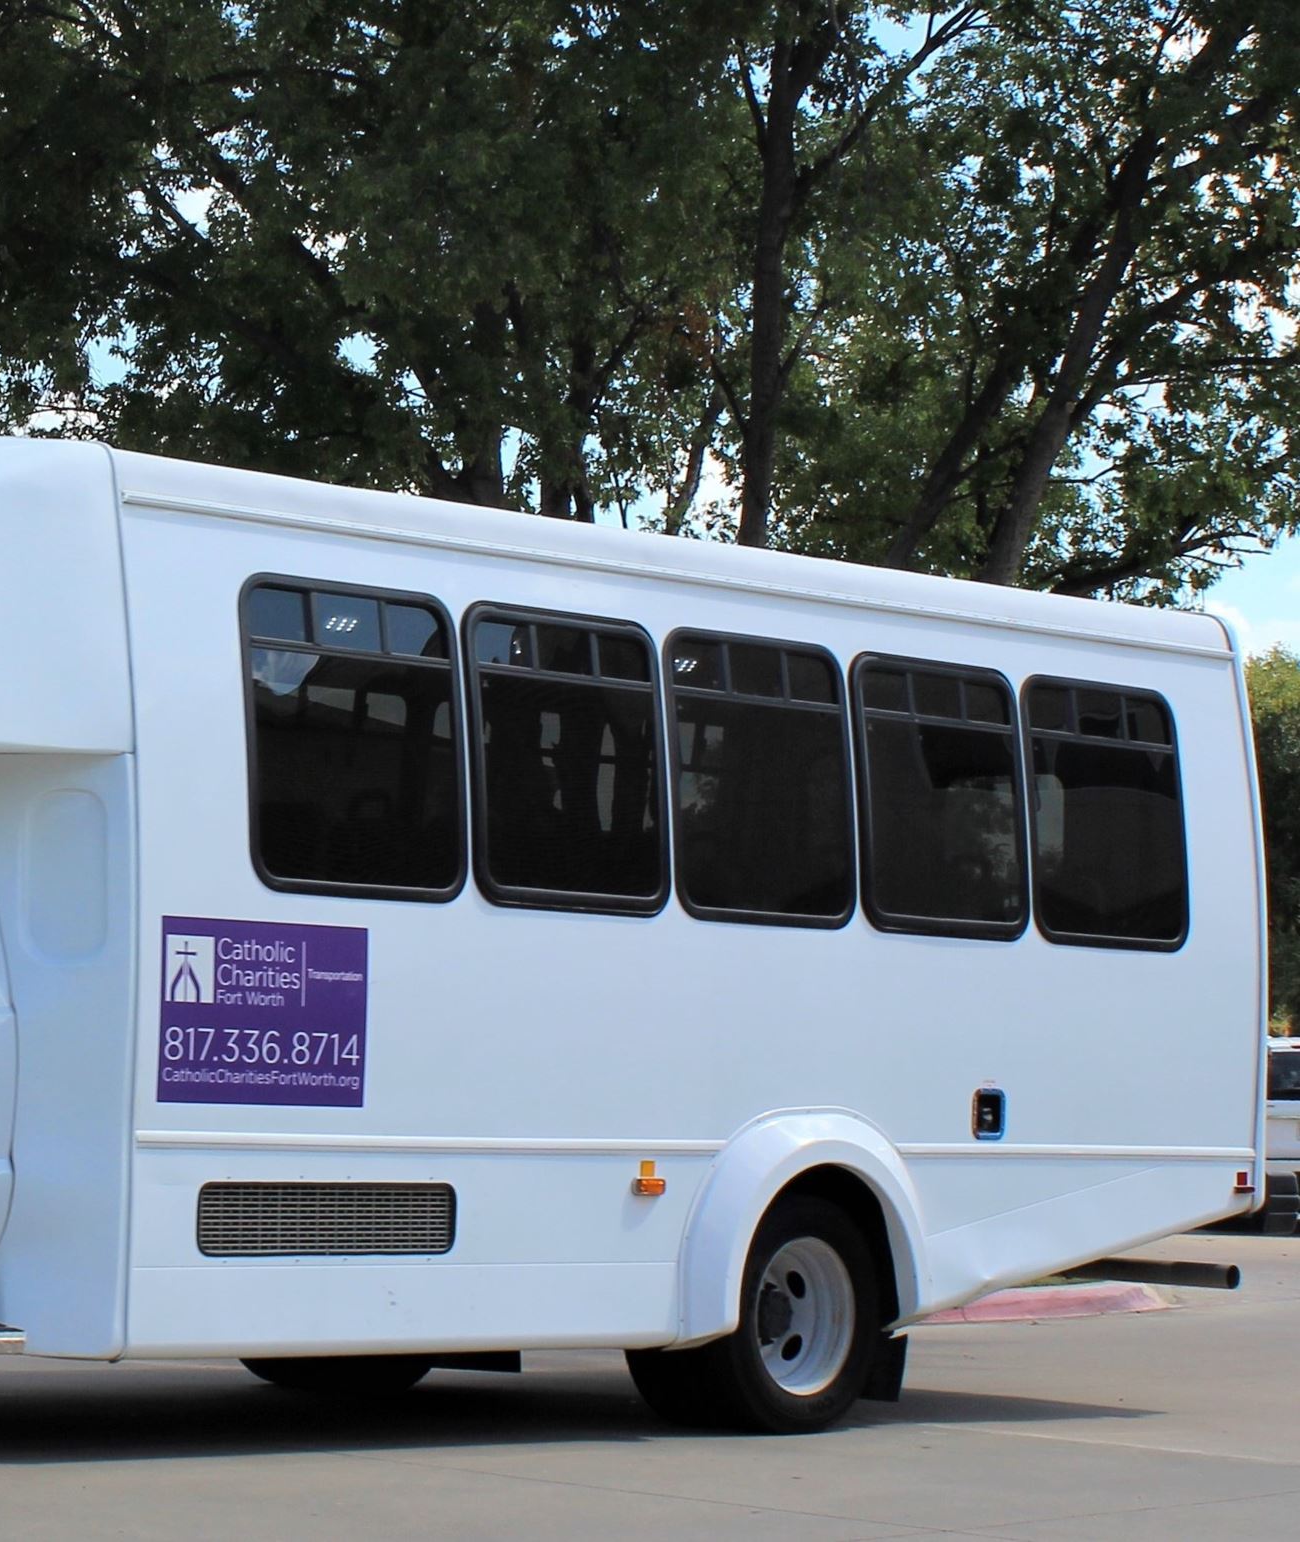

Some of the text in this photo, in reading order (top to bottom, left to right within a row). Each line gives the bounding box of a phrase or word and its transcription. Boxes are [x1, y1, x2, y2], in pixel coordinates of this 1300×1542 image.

[216, 938, 296, 963] Catholic
[216, 964, 301, 990] Charities
[307, 968, 364, 984] Transportation
[216, 989, 285, 1007] Fort Worth
[163, 1026, 360, 1066] 817.336.8714
[161, 1067, 360, 1090] CatholicCharitiesFortWorth.org
